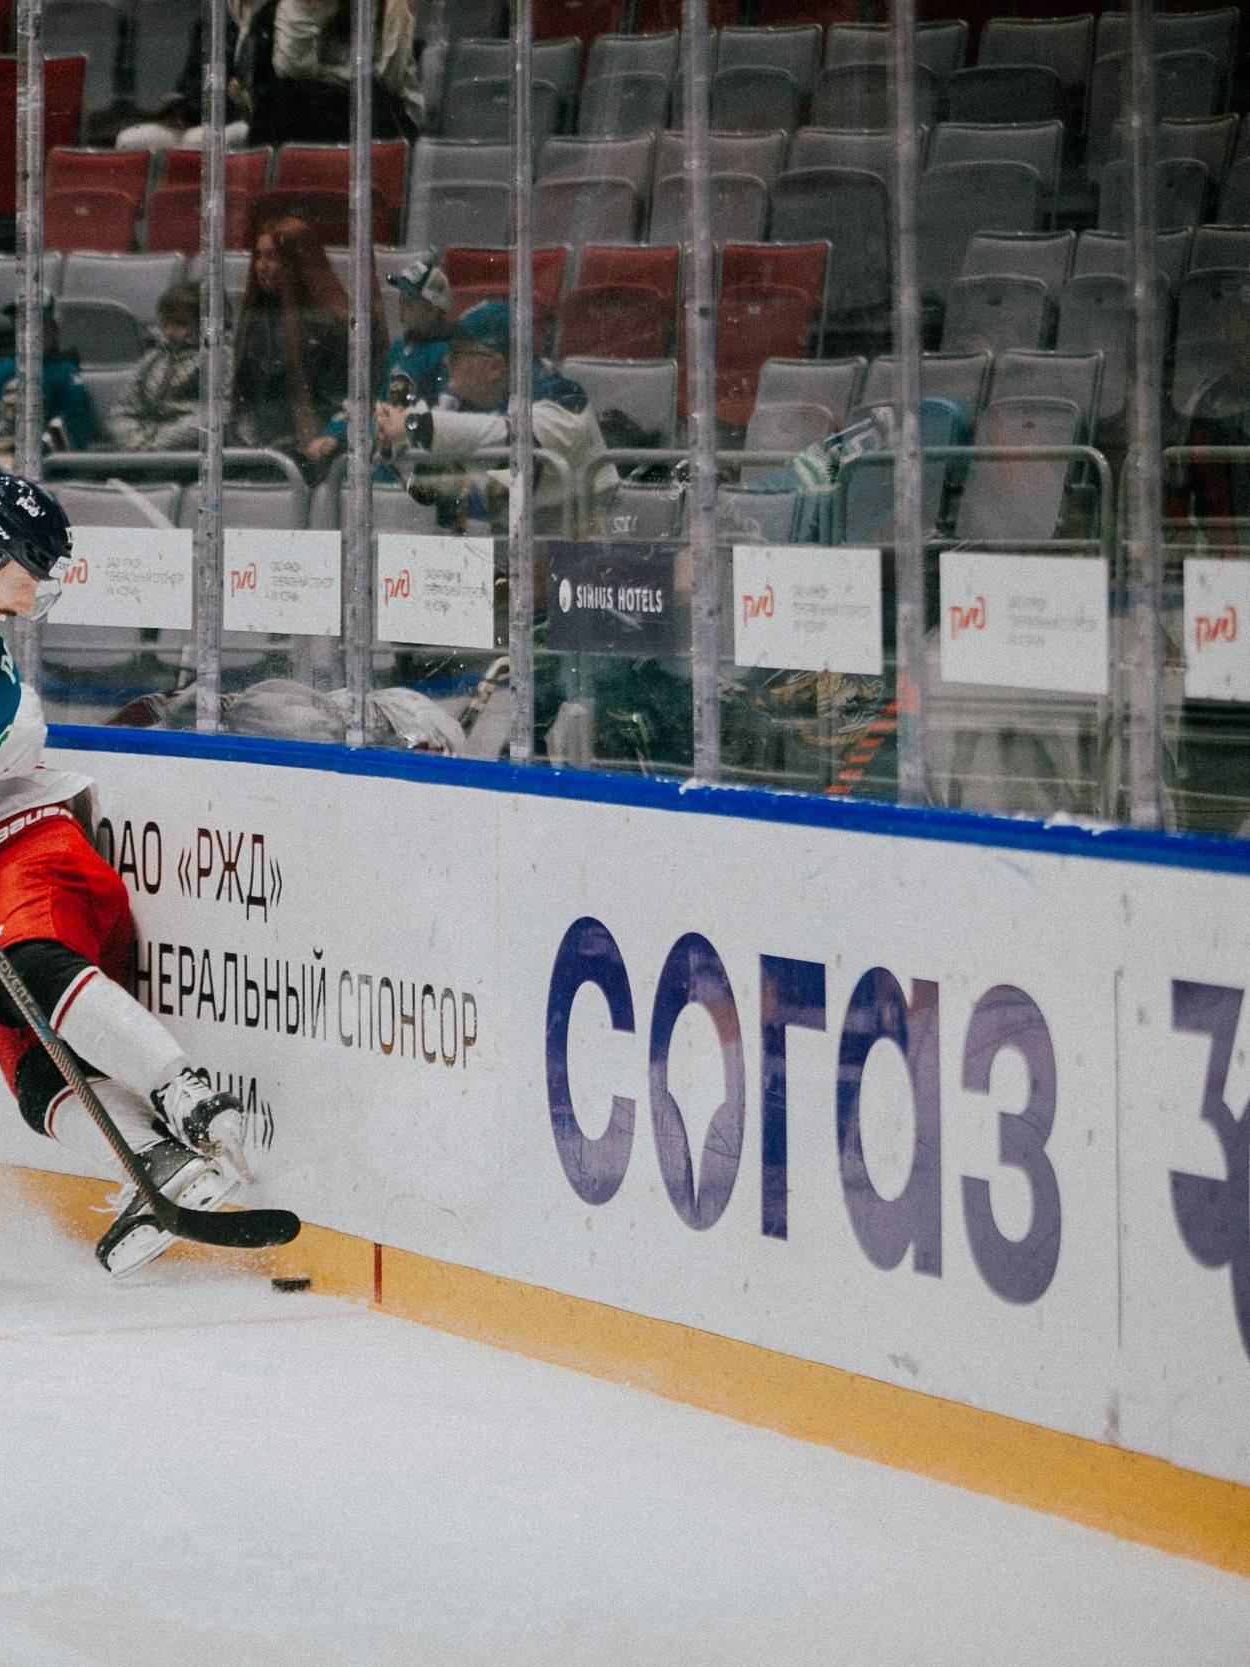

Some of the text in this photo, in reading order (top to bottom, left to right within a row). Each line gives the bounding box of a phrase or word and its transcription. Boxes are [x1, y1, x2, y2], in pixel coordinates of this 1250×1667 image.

[576, 585, 663, 613] SIRIUS HOTELS
[96, 817, 283, 923] ОАО «РЖД»
[133, 941, 479, 1069] НЕРАЛЬНЫЙ СПОНСОР
